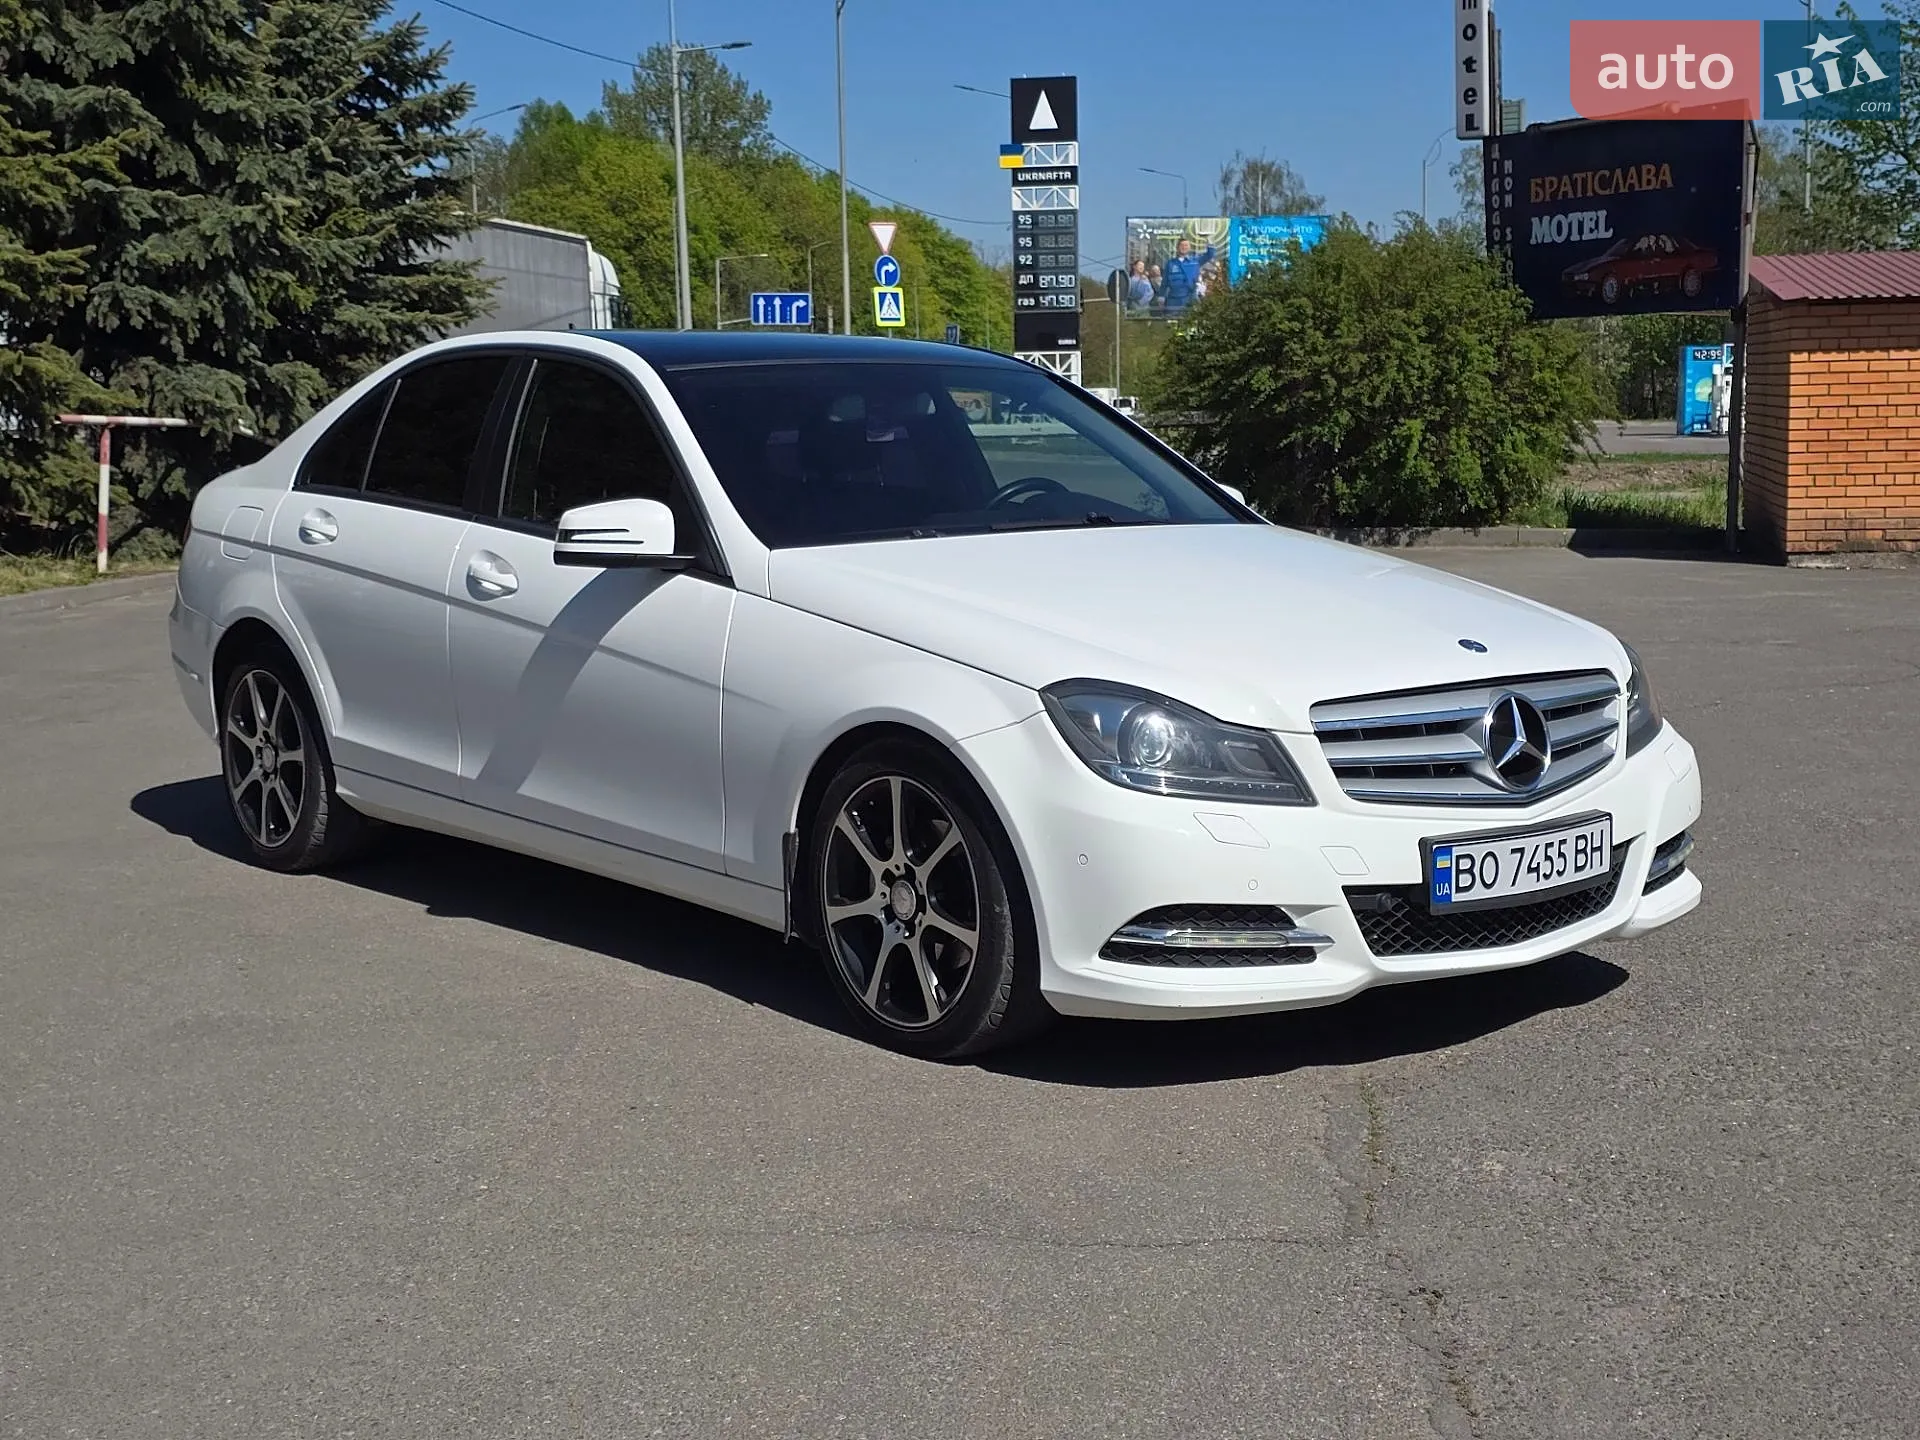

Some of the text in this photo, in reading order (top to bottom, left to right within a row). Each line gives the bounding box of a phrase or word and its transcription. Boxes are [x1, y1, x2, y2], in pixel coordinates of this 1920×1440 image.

[1018, 171, 1071, 181] UKRNAFTA
[1530, 163, 1674, 204] БРАТІСЛАВА
[1018, 215, 1032, 224] 95
[1530, 209, 1613, 245] MOTEL
[1018, 237, 1032, 247] 95
[1019, 255, 1032, 264] 92
[1039, 275, 1076, 288] 87.90
[1039, 295, 1076, 307] 47.90
[1455, 829, 1604, 894] BO 7455 BH
[1436, 883, 1450, 895] UA
